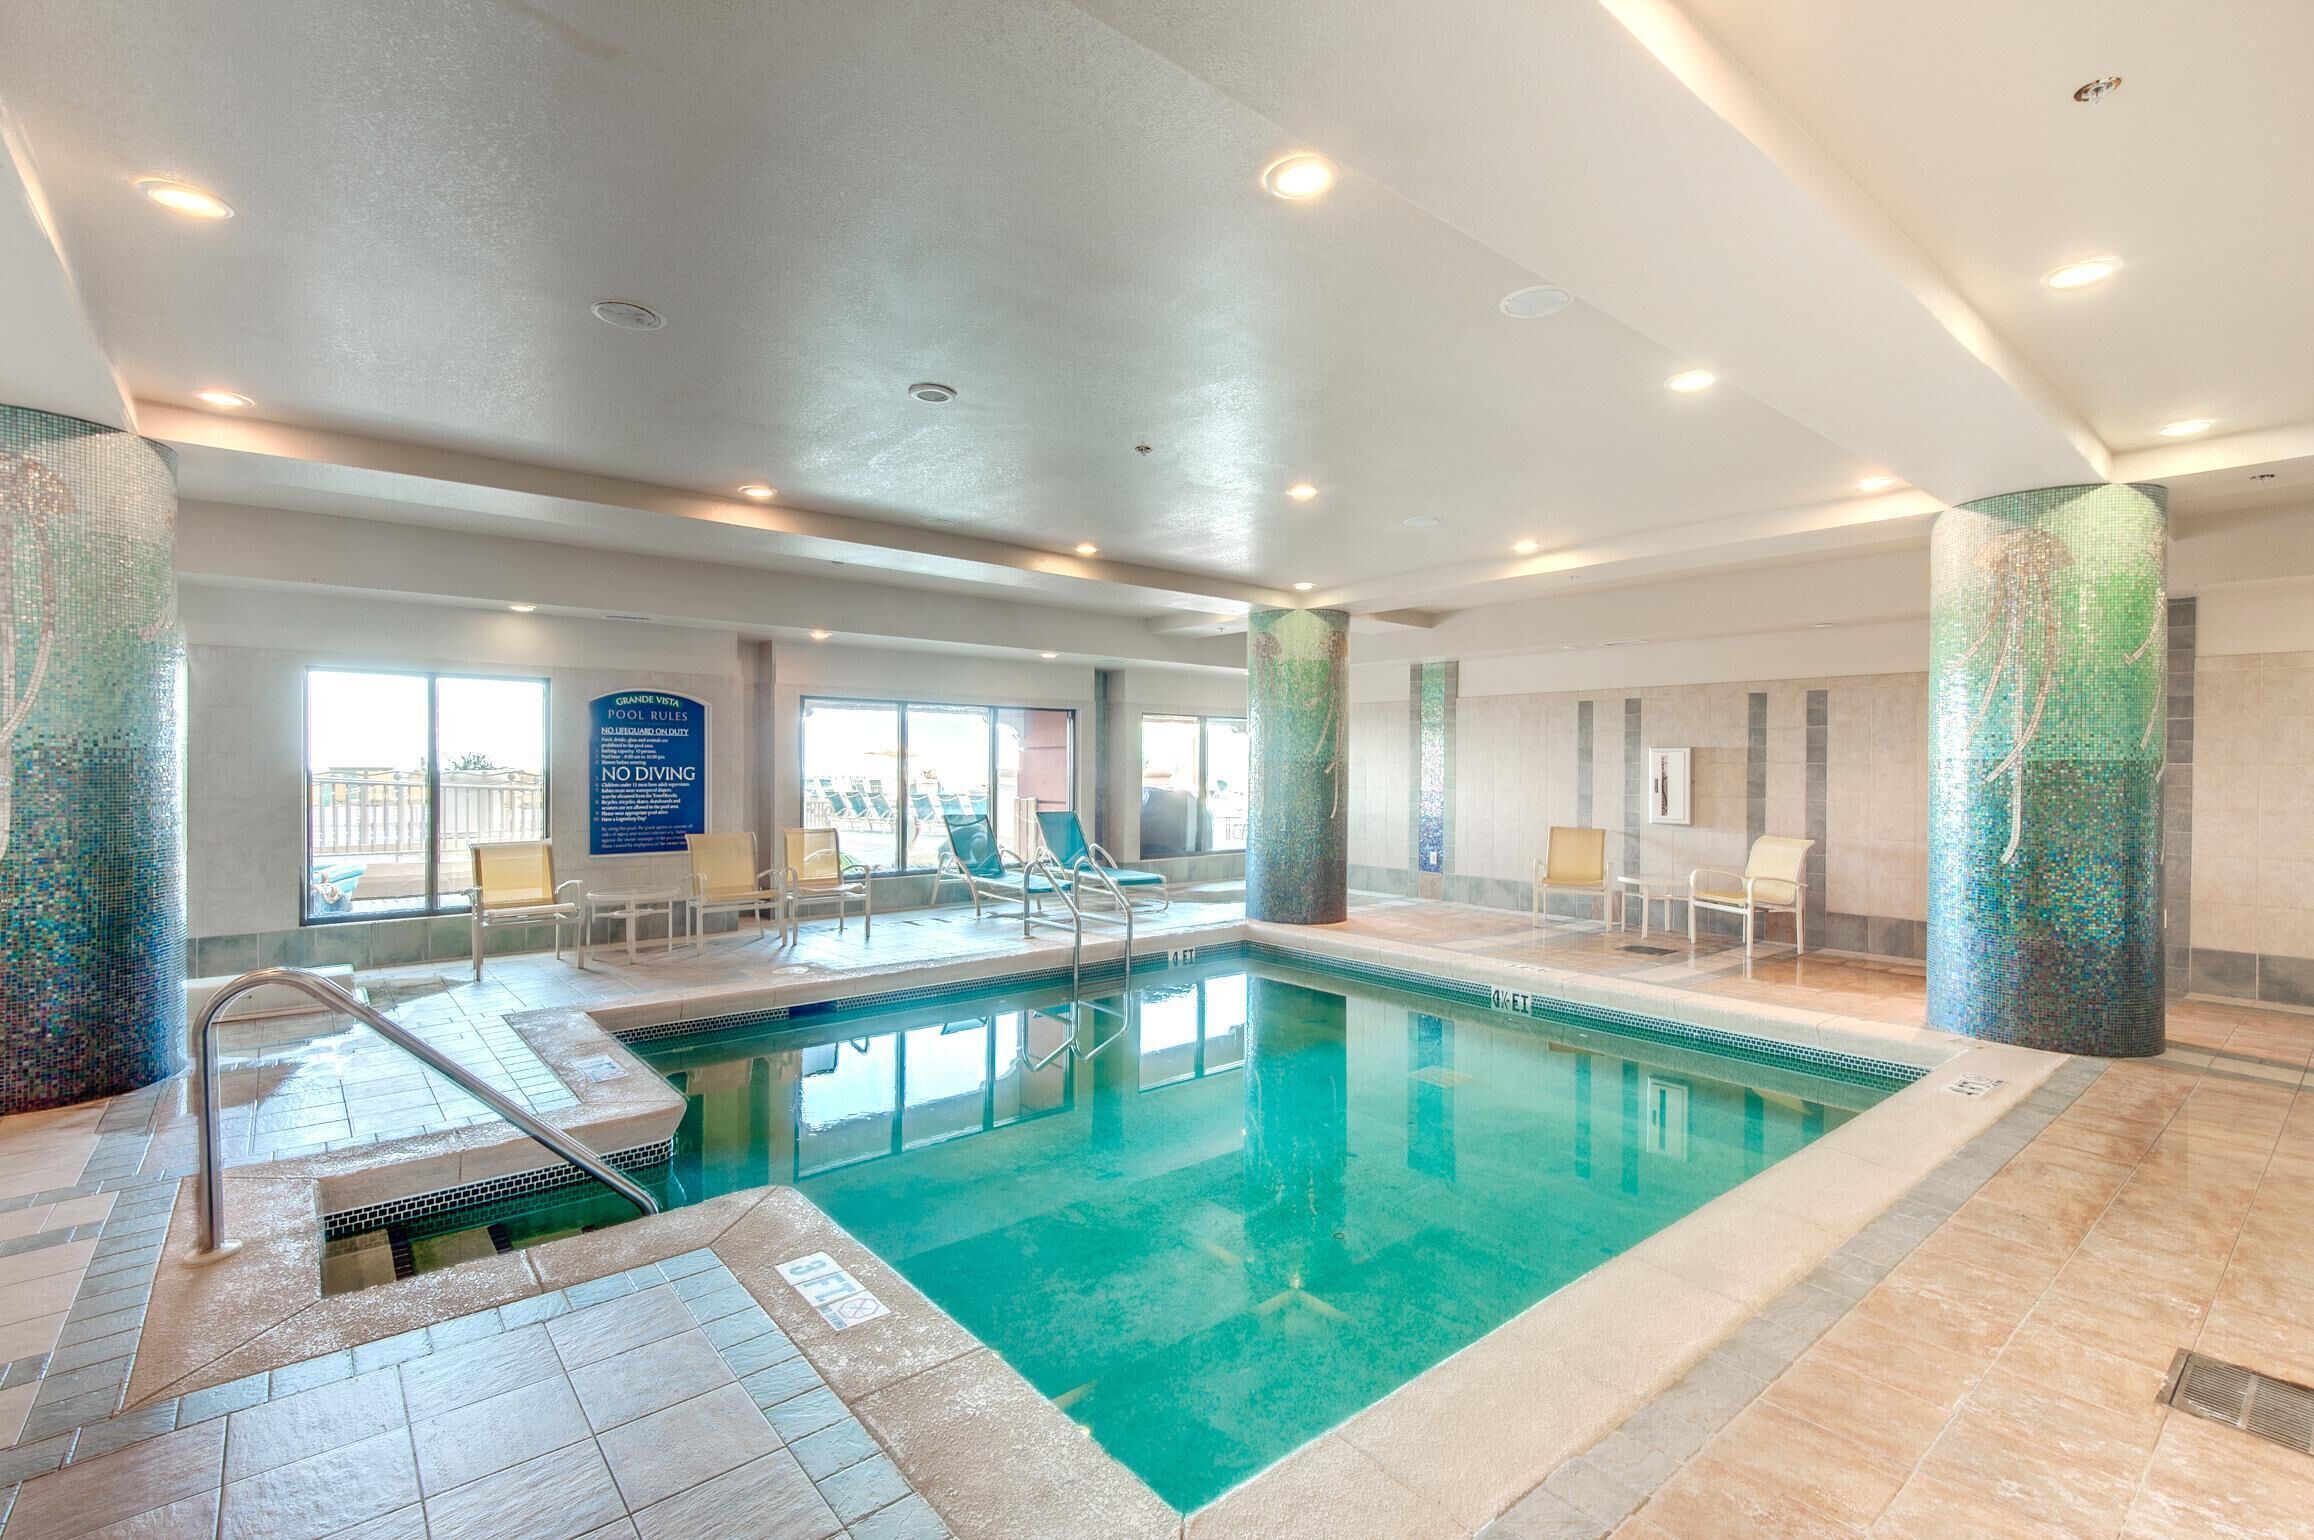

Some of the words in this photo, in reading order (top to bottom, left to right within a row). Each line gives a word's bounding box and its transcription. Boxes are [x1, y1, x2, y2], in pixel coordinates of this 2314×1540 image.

[616, 696, 654, 705] GRANDE
[656, 696, 678, 707] VISTA
[608, 710, 644, 720] POOL
[650, 711, 688, 721] RULES
[602, 766, 630, 780] NO
[636, 766, 696, 780] DIVING
[790, 1260, 826, 1275] 3
[802, 1274, 856, 1302] FT
